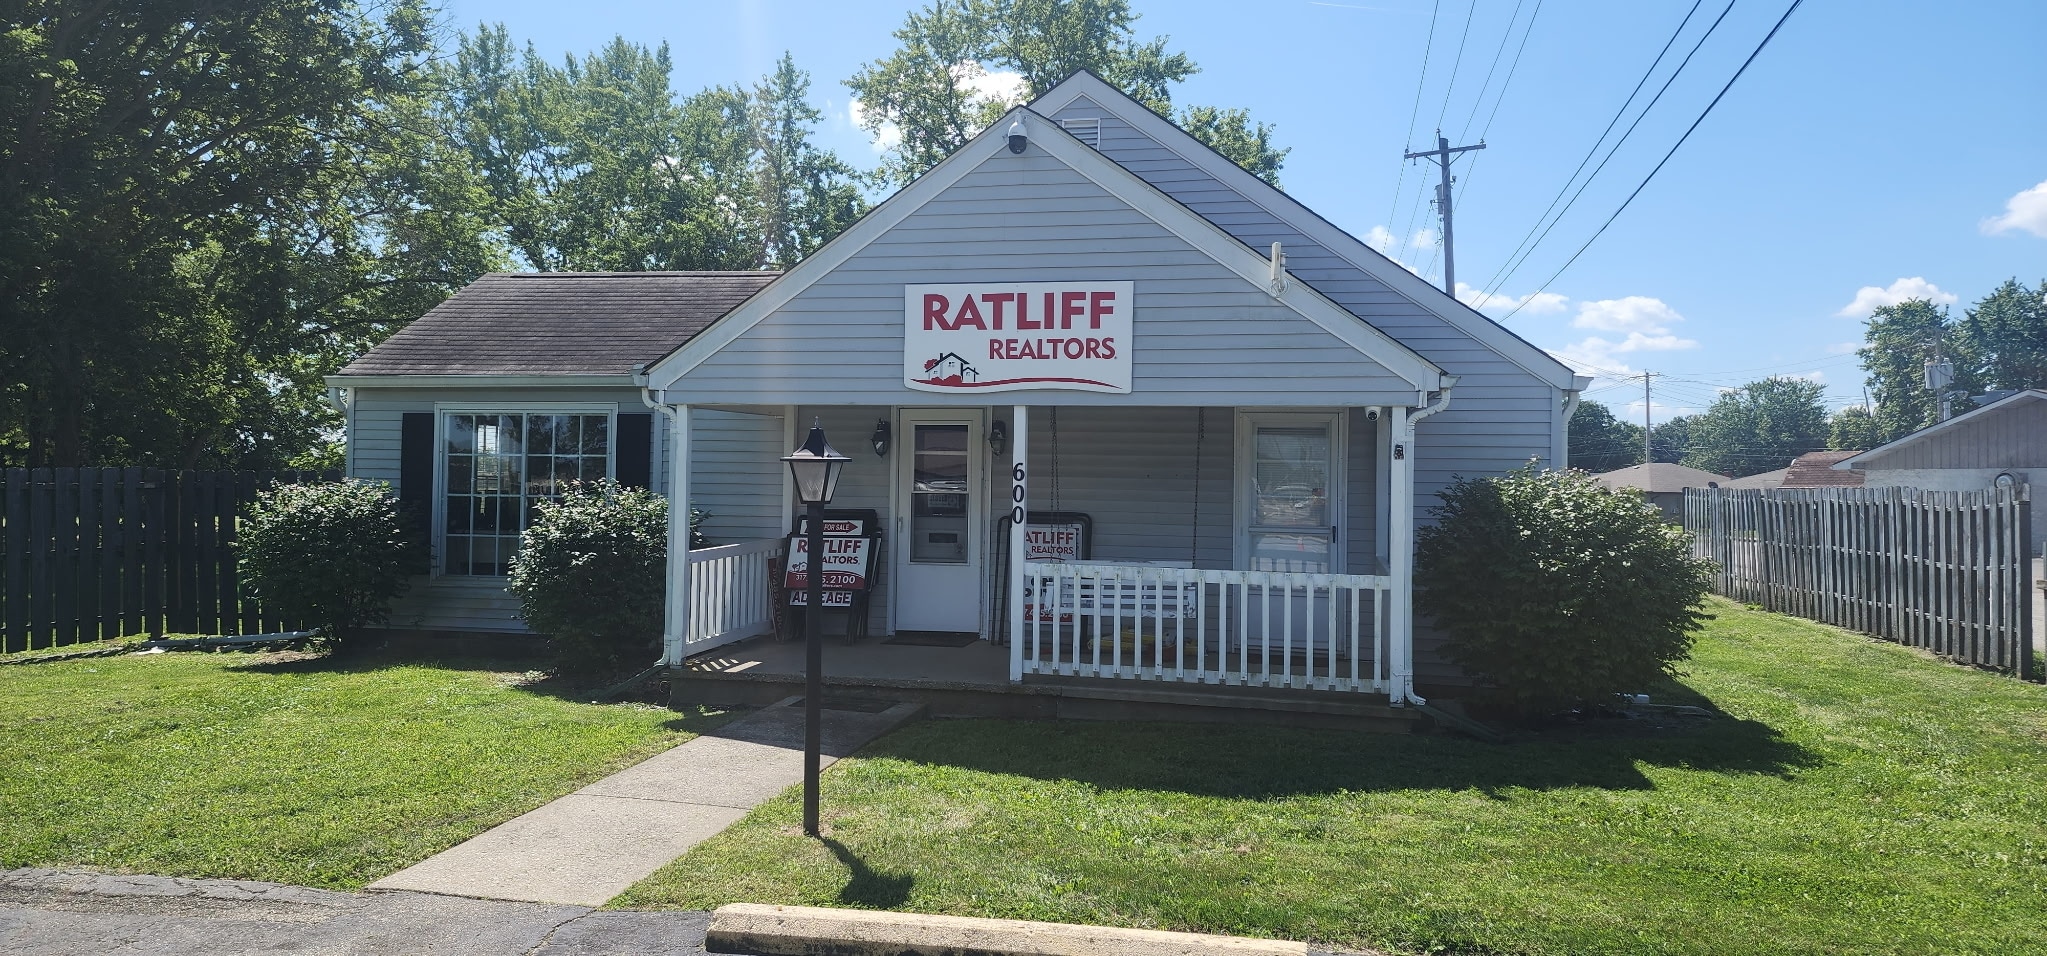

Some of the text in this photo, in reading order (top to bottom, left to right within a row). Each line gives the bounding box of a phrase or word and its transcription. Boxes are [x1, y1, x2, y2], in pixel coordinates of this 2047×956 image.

[923, 291, 1116, 331] RATLIFF
[1012, 462, 1025, 524] 600
[823, 523, 850, 531] FOR SALE
[1026, 530, 1074, 545] ATLIFF
[796, 539, 862, 554] RLIFF
